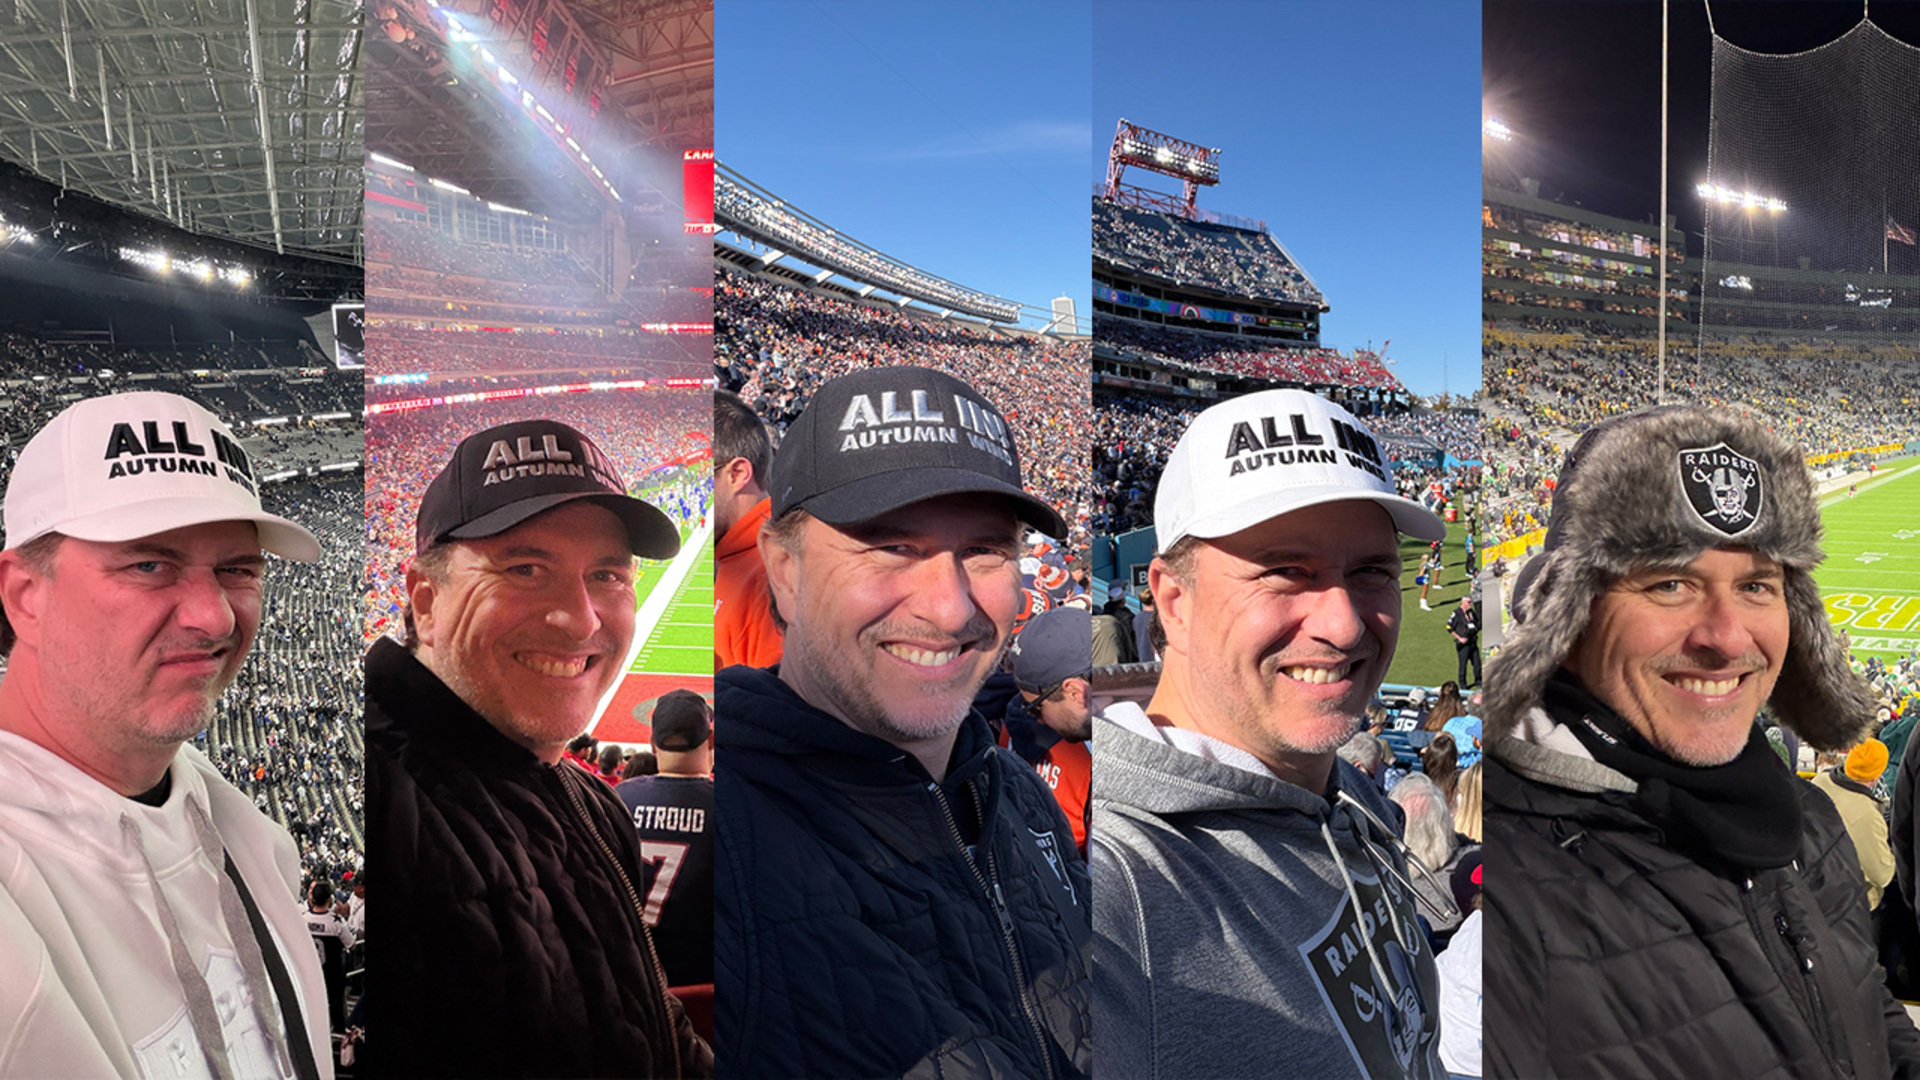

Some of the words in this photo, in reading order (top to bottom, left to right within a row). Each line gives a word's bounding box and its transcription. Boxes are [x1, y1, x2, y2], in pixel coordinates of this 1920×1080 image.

[838, 389, 944, 431] ALL
[953, 394, 1010, 449] IN!
[104, 421, 205, 460] ALL
[839, 425, 958, 452] AUTUMN
[1224, 413, 1324, 459] ALL
[482, 434, 572, 470] ALL
[1229, 449, 1337, 477] AUTUMN
[1685, 453, 1756, 472] RAIDERS
[108, 457, 218, 480] AUTUMN
[483, 462, 586, 487] AUTUMN
[633, 805, 705, 833] STROUD
